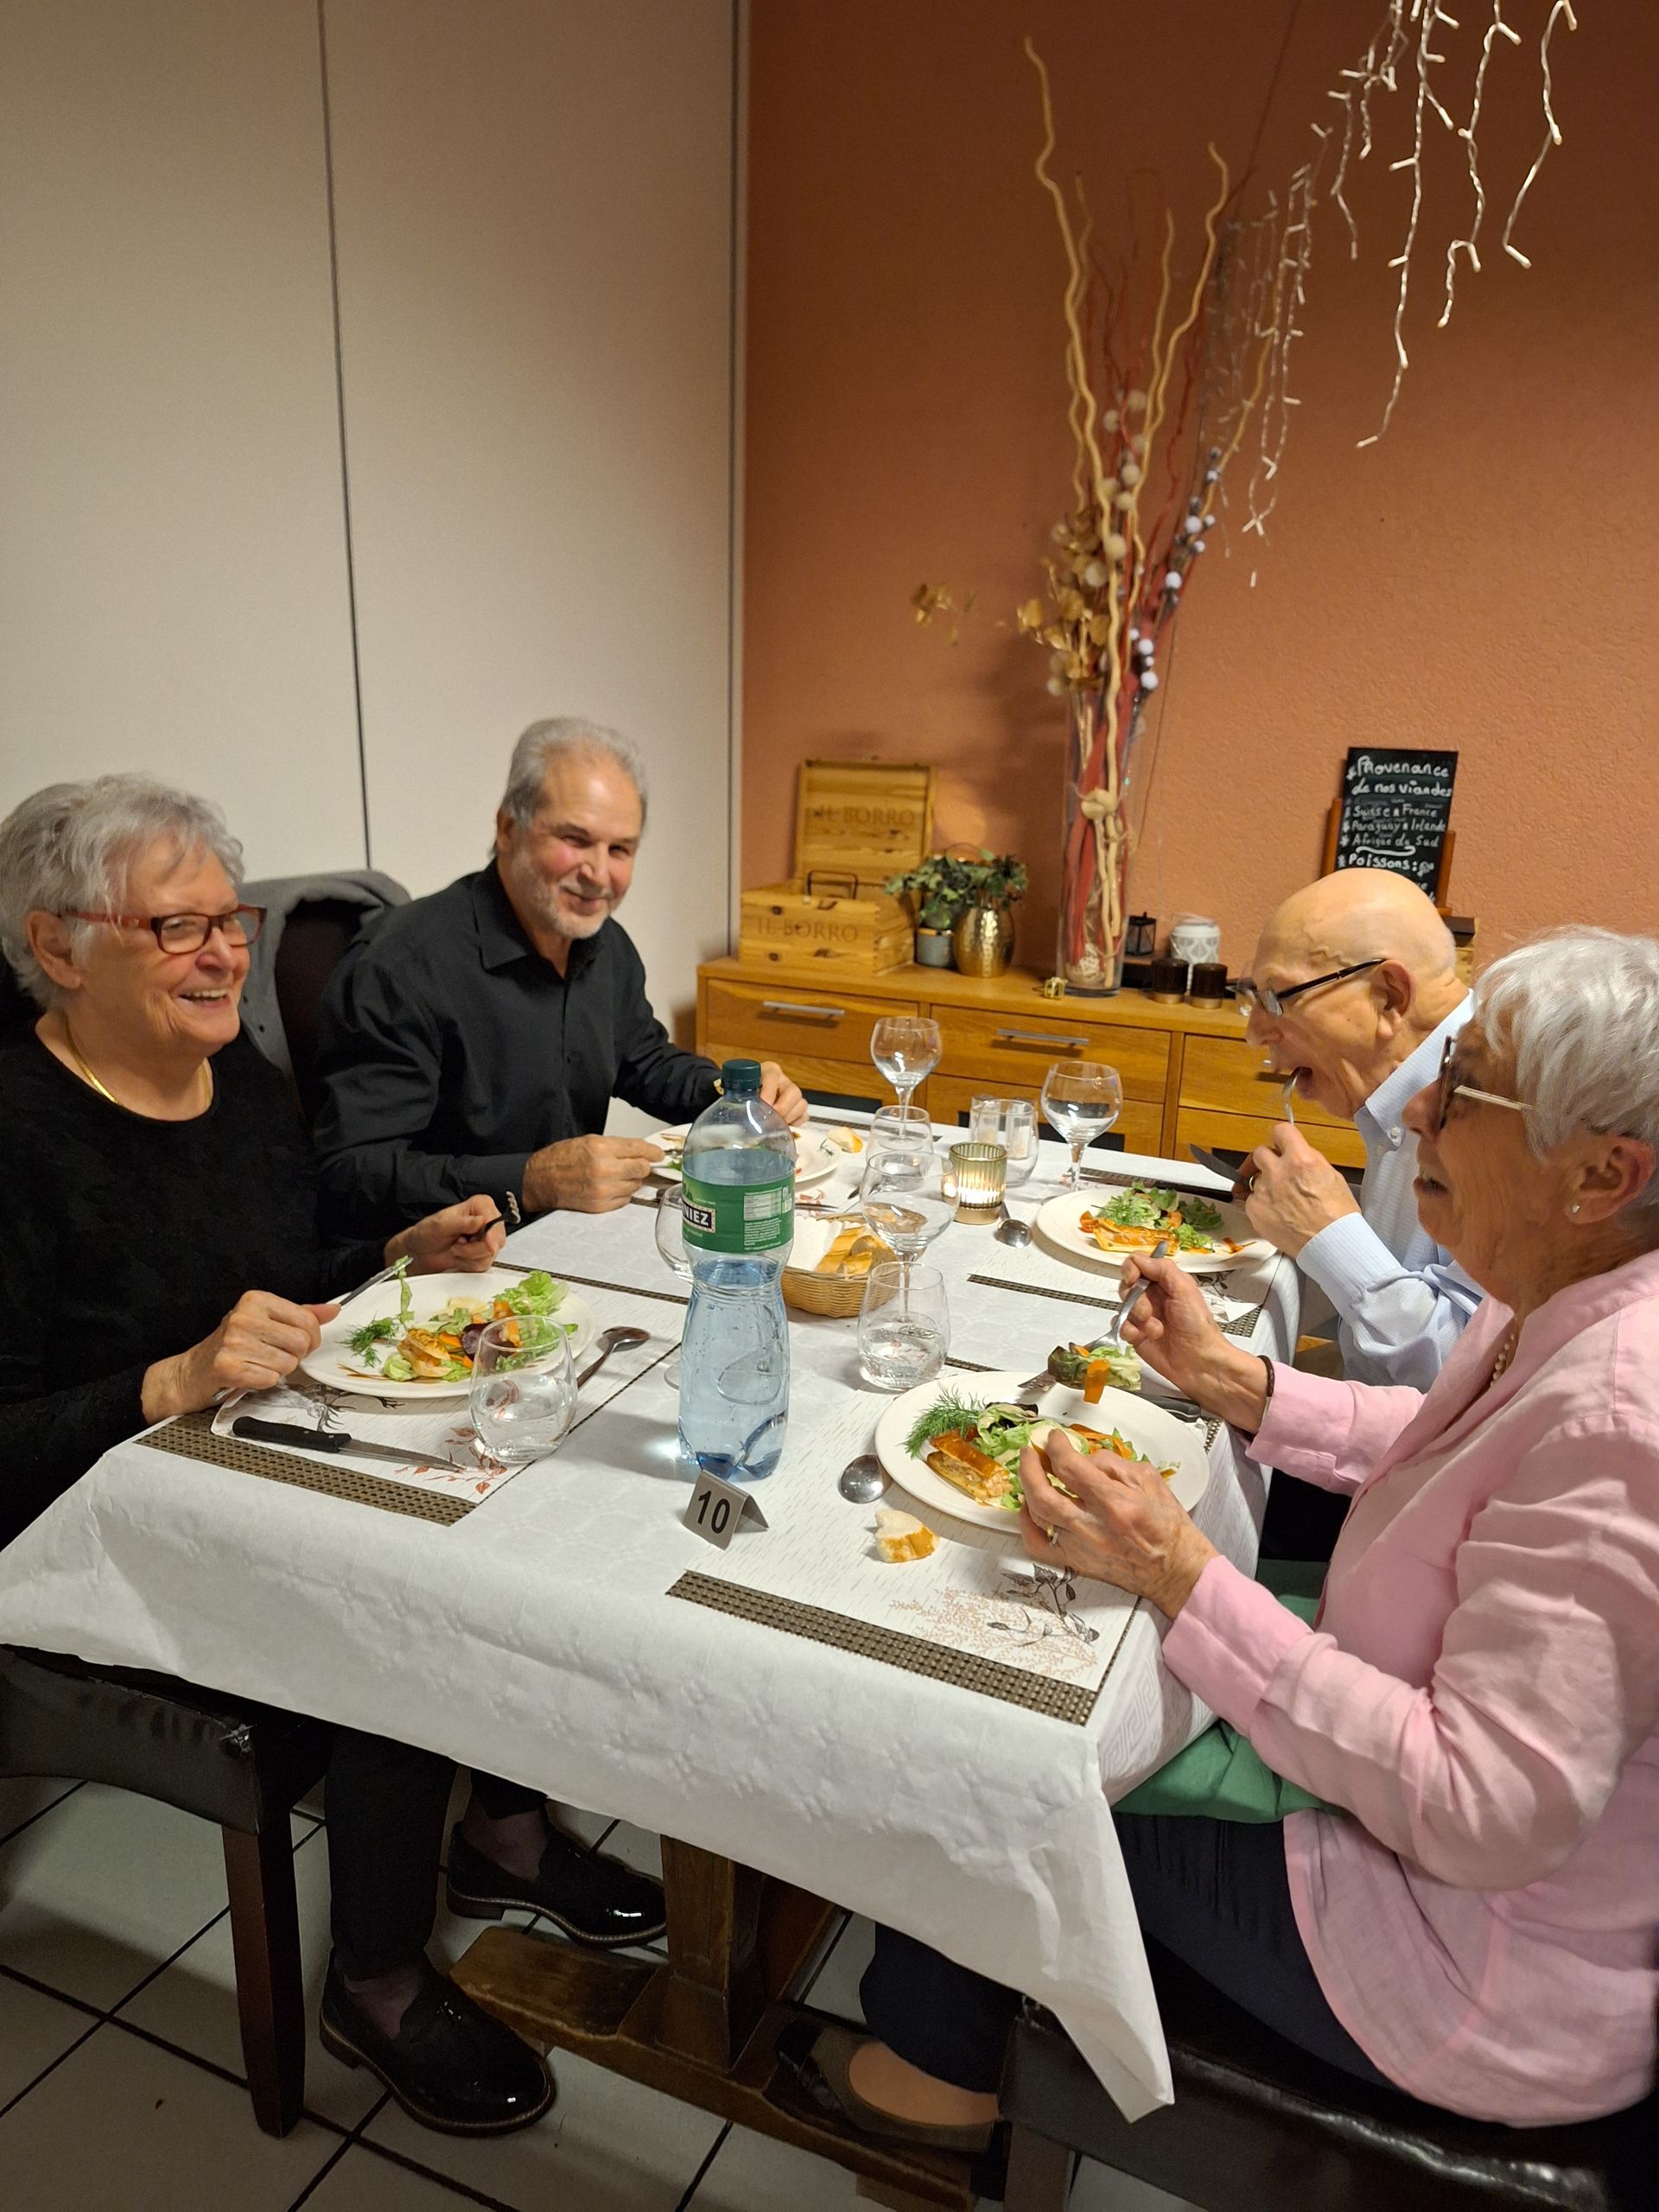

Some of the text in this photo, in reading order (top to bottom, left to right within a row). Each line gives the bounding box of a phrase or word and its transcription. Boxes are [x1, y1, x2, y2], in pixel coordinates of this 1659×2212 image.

[1374, 783, 1395, 793] nos
[1399, 780, 1452, 797] viandes
[1402, 804, 1437, 817] France
[784, 919, 859, 942] BORRO
[697, 1491, 730, 1534] 10
